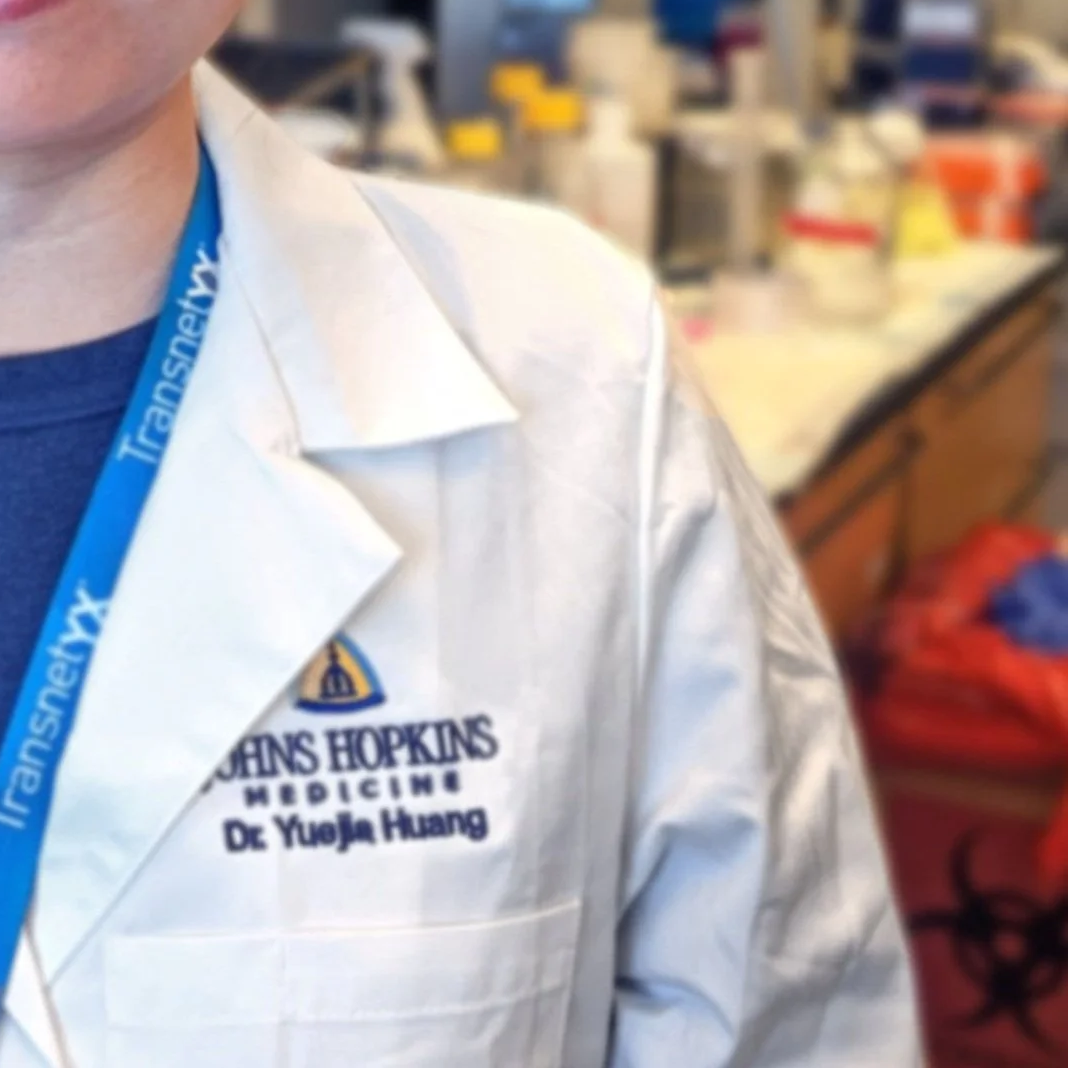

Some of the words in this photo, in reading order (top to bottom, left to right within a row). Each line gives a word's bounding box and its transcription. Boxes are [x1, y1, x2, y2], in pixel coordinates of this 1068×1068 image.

[116, 245, 218, 465] Transnetyx
[202, 730, 320, 792] OHNS
[324, 715, 499, 772] HOPKINS
[243, 770, 461, 809] MEDICINE
[381, 806, 489, 842] Huang
